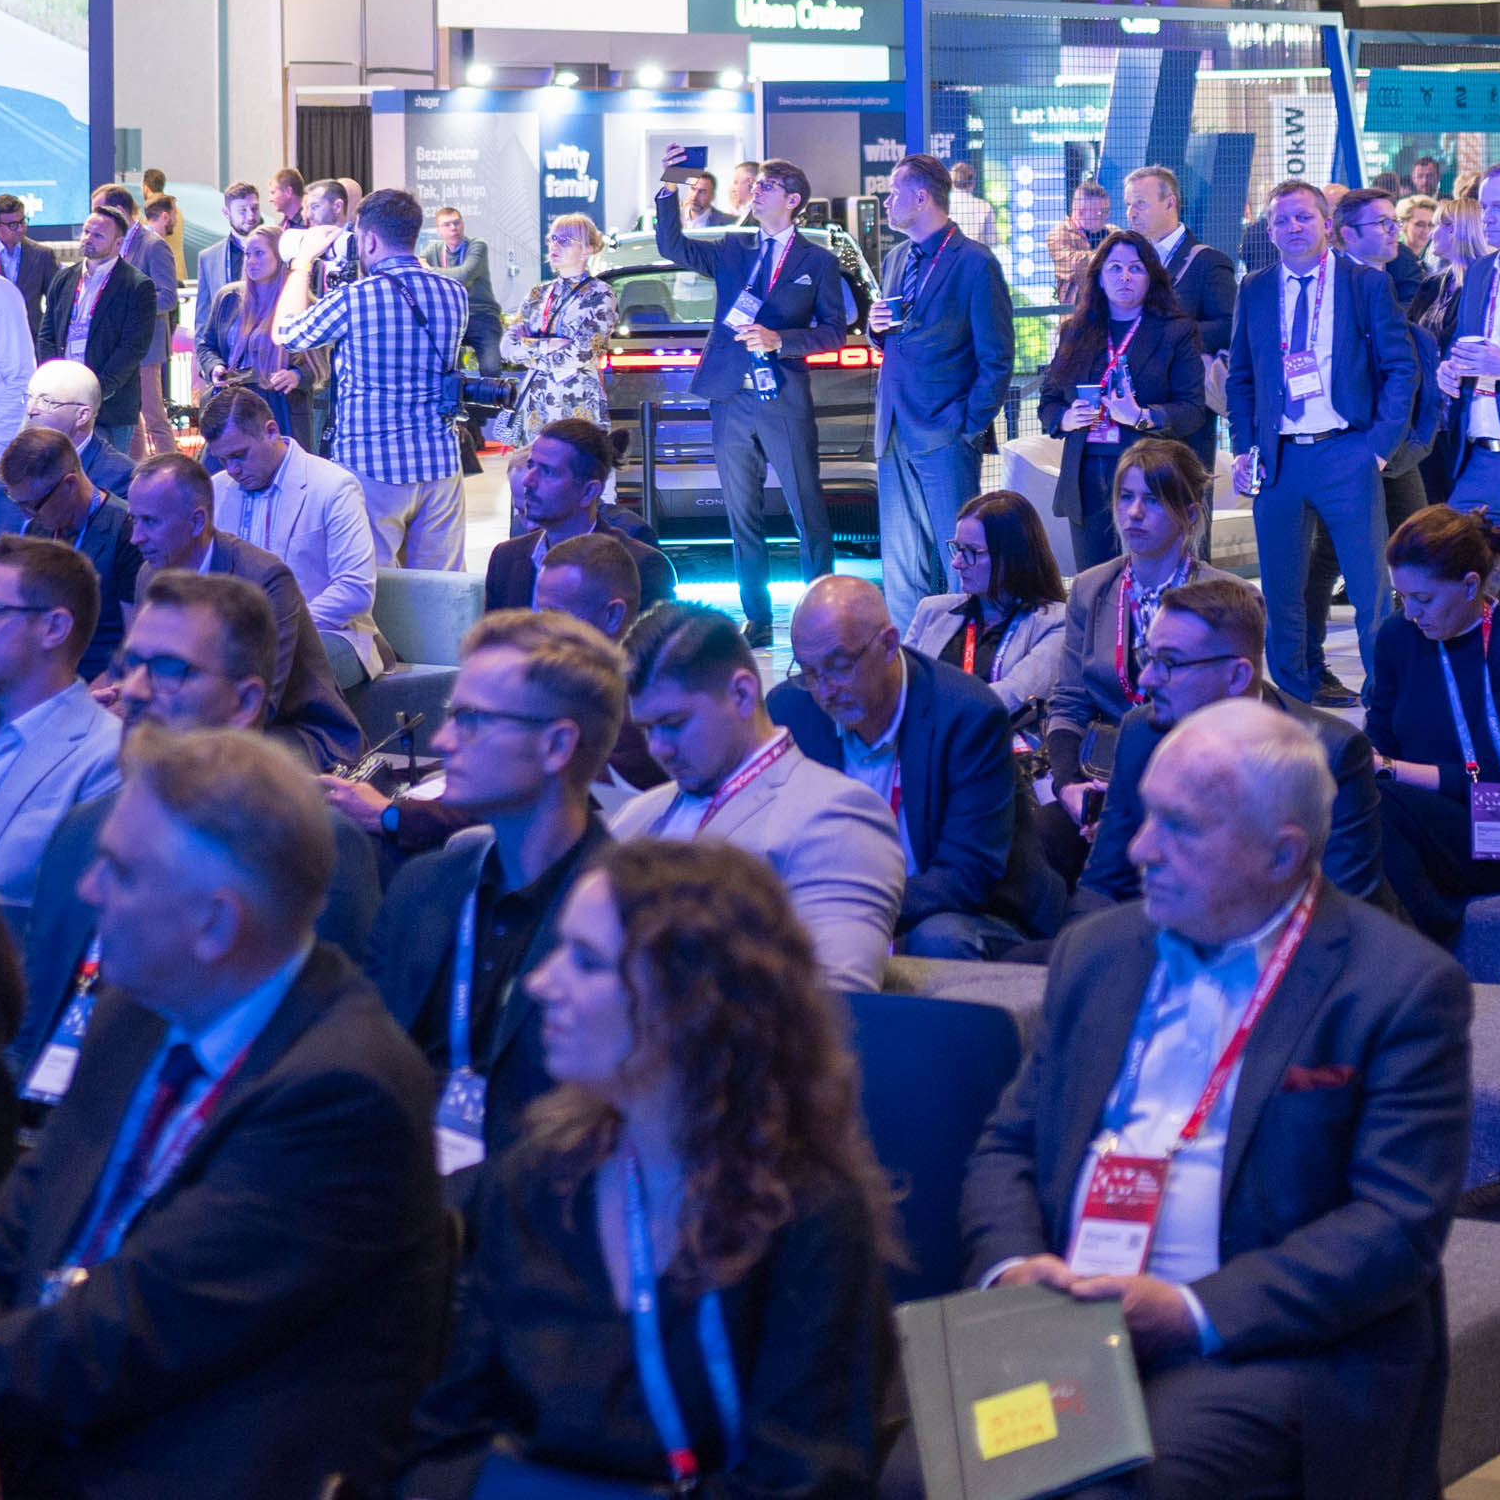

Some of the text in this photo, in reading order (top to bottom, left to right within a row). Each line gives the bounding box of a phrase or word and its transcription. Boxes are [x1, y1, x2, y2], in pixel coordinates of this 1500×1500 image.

[416, 146, 479, 164] Bezpieczne
[545, 143, 590, 175] witty
[864, 138, 907, 164] witty
[442, 183, 460, 201] jak
[462, 184, 486, 201] tego
[545, 173, 599, 203] family
